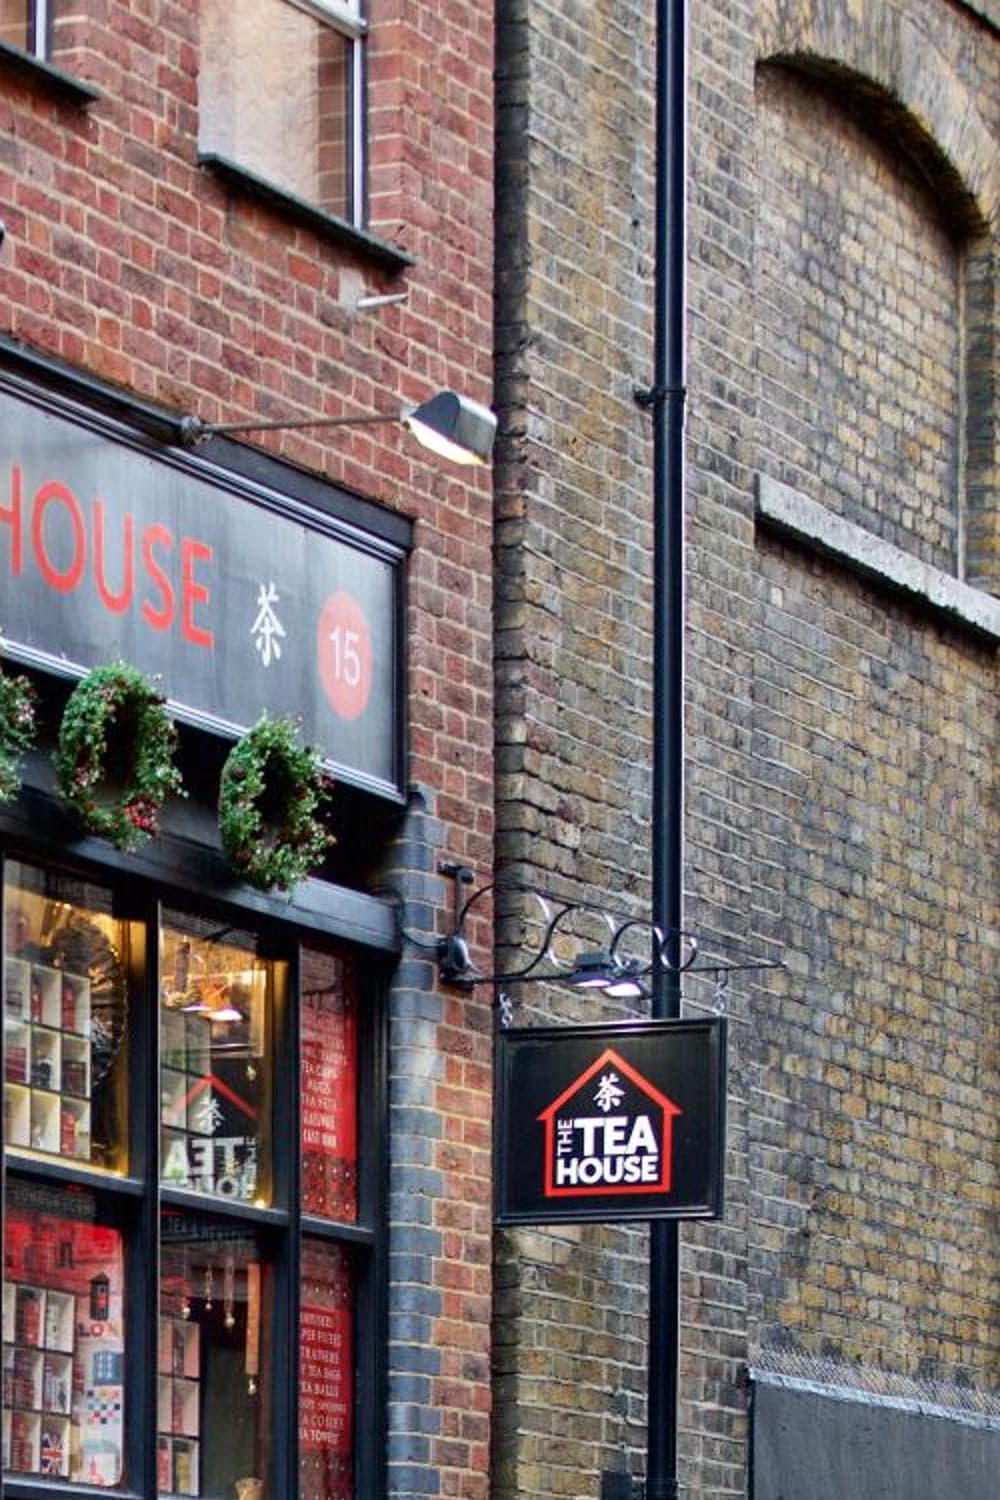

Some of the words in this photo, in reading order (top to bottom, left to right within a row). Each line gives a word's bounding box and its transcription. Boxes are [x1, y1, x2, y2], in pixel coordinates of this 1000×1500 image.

[249, 581, 287, 668] 茶
[328, 625, 362, 687] 15
[593, 1073, 626, 1113] 茶
[557, 1119, 574, 1157] THE
[574, 1114, 659, 1157] TEA
[556, 1155, 660, 1185] HOUSE
